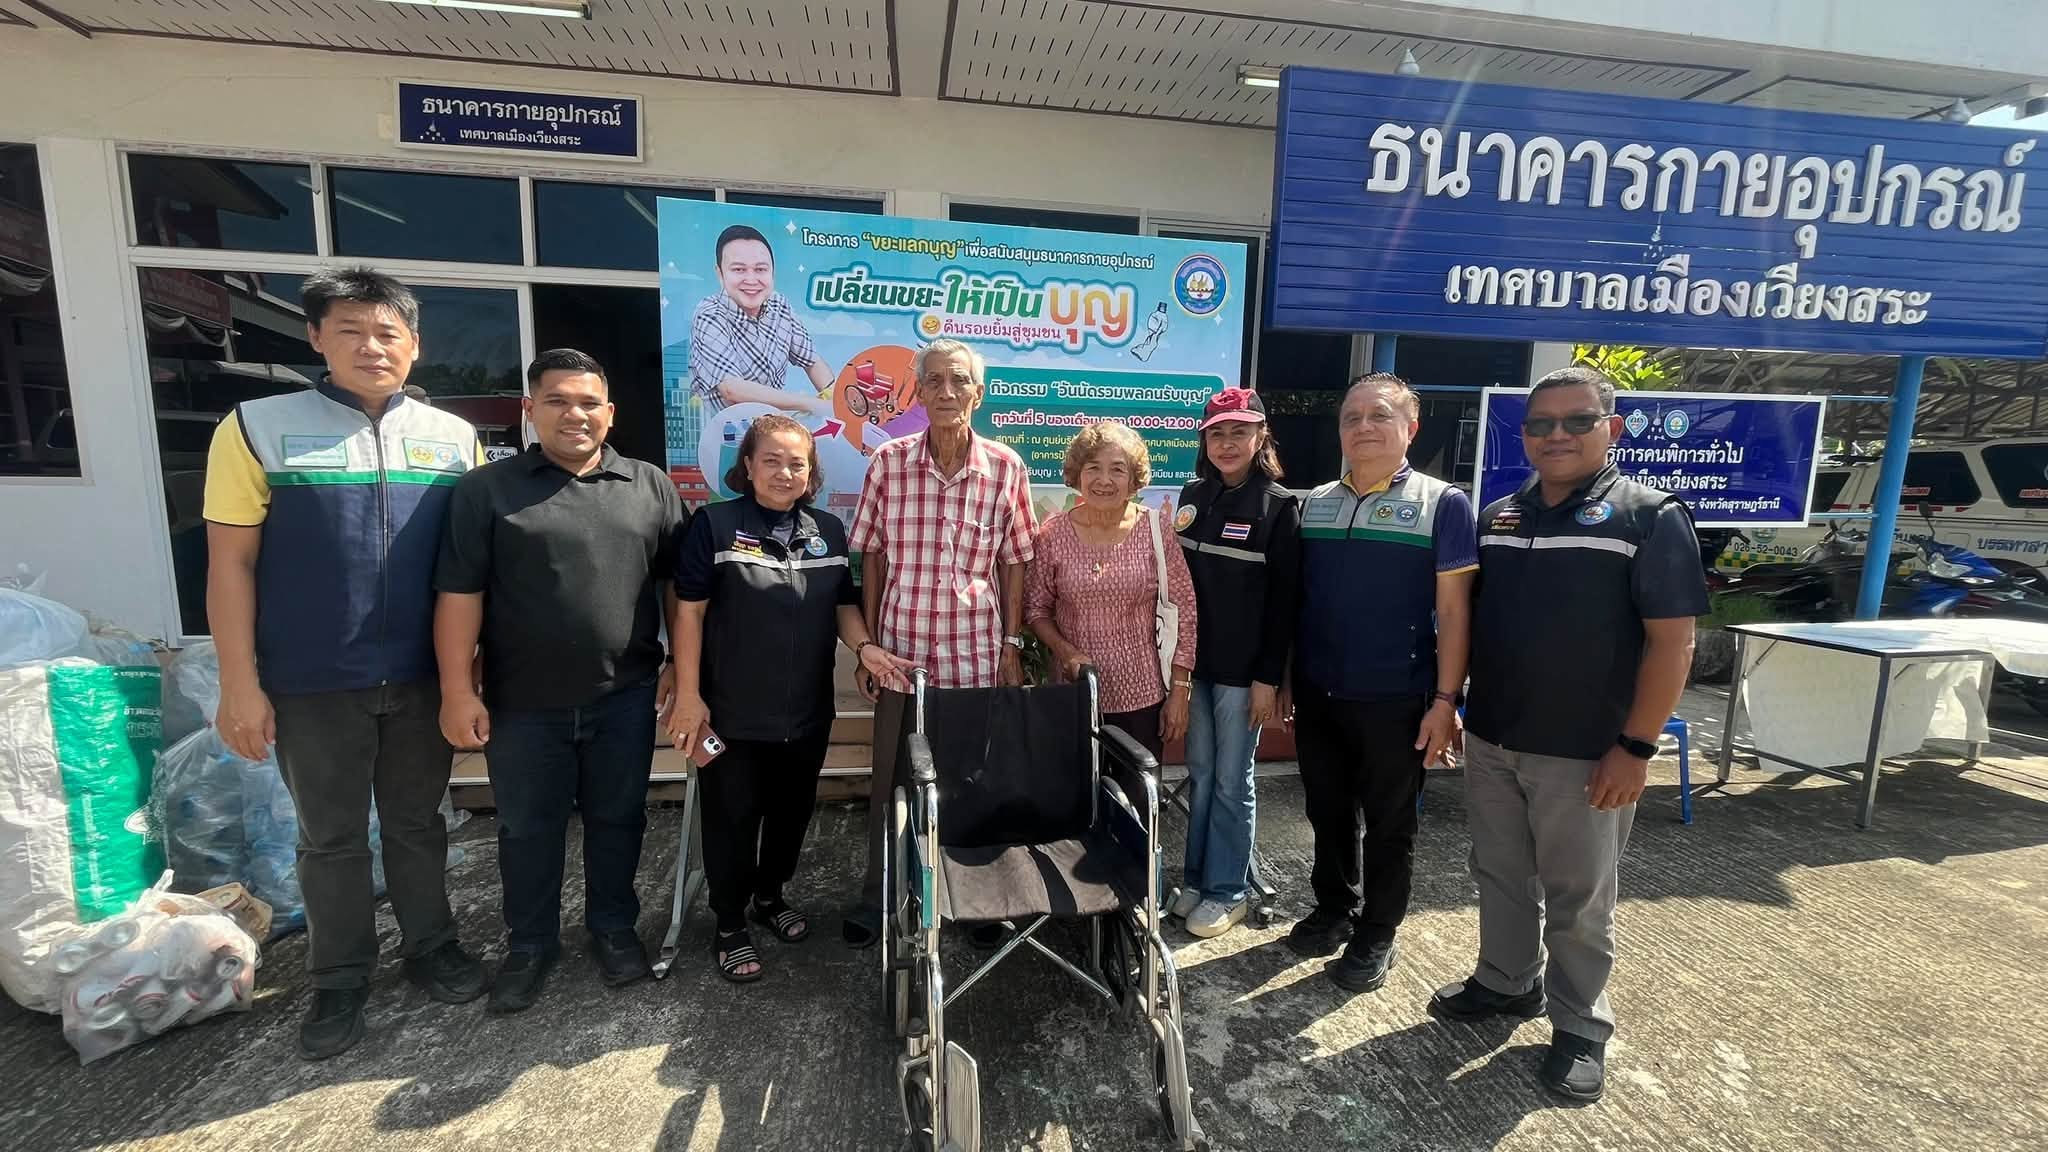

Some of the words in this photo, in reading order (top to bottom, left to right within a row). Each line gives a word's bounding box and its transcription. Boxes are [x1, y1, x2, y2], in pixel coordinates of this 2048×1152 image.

[422, 97, 622, 130] ธนาคารกายอุปกรณ์
[460, 127, 582, 145] เทศบาลเมืองเวียงสระ
[1366, 122, 2036, 258] ธนาคารกายอุปกรณ์
[802, 228, 860, 248] โครงการ
[1444, 253, 1932, 325] เทศบาลเมืองเวียงสระ
[990, 379, 1047, 397] กิจกรรม
[992, 409, 1033, 427] ทุกวันที่
[1035, 413, 1044, 424] 5
[1128, 416, 1194, 429] 10.00-12.00
[1607, 438, 1744, 465] ริการคนพิการทั่วไป
[1620, 468, 1728, 490] มืองเวียงสระ
